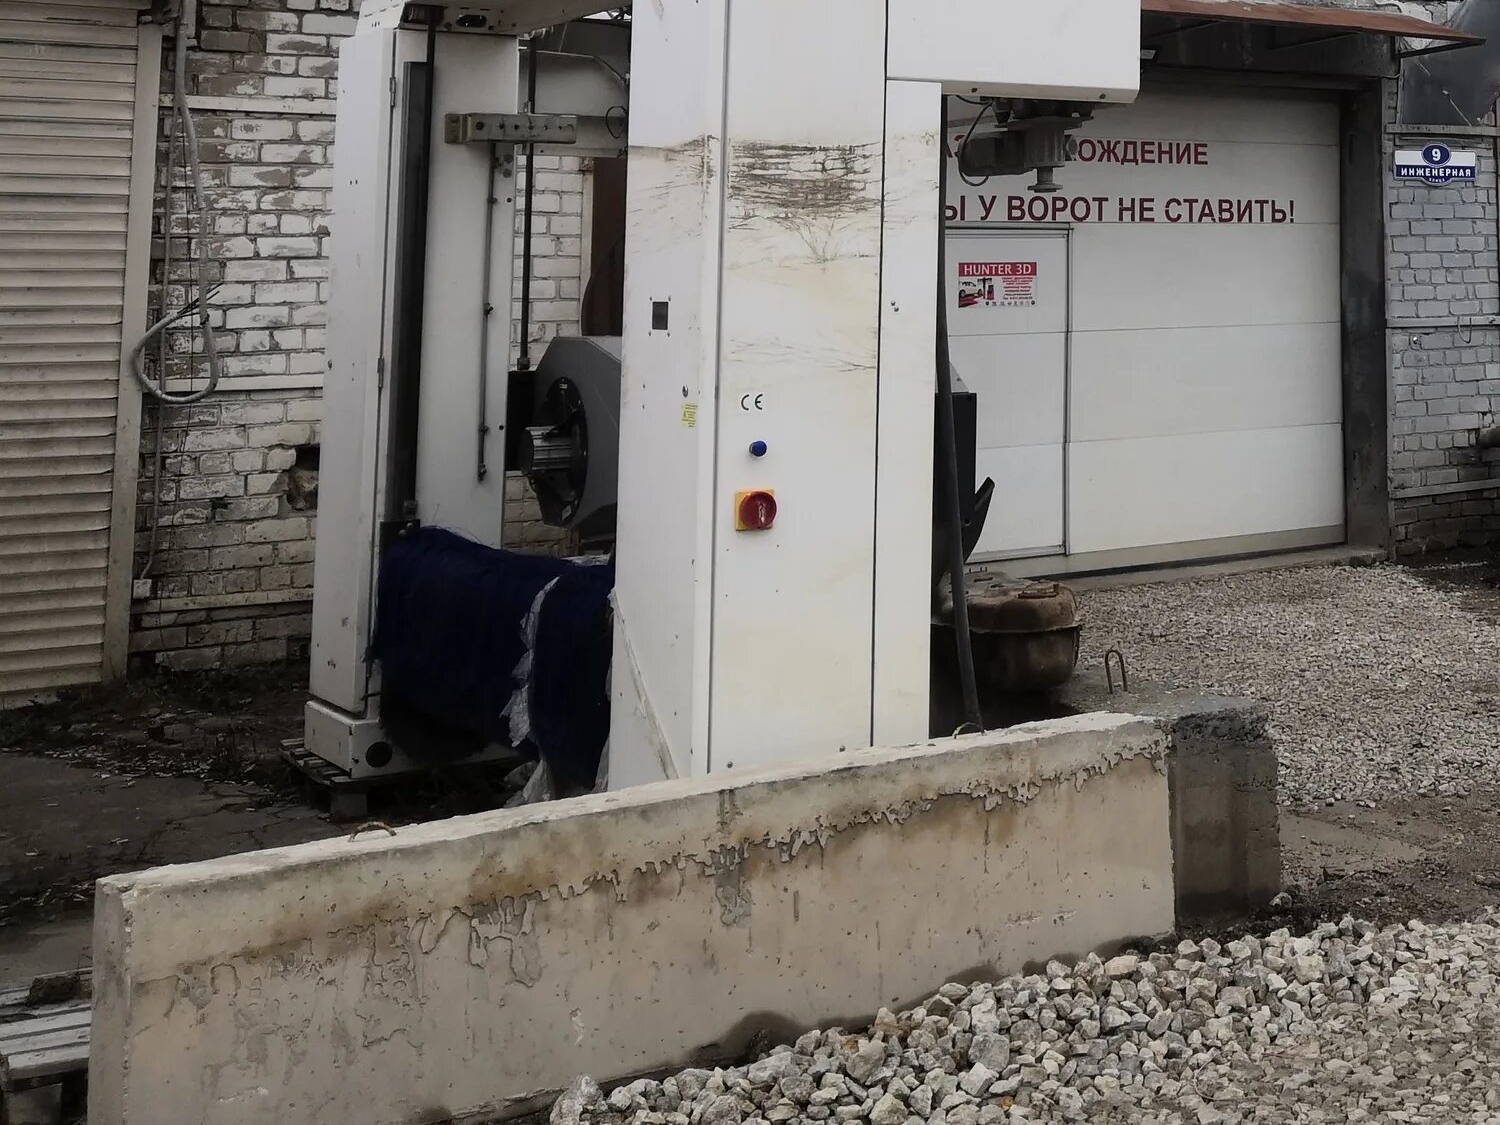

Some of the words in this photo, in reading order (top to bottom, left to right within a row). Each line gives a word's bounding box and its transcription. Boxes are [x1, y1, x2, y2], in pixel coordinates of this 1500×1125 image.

[1431, 148, 1441, 161] 9
[1401, 167, 1471, 177] ИНЖЕНЕРНАЯ
[978, 195, 997, 221] У
[1007, 195, 1108, 222] ВОРОТ
[1118, 197, 1154, 222] НЕ
[1164, 197, 1294, 224] СТАВИТЬ!
[964, 264, 1011, 275] HUNTER
[1015, 264, 1031, 274] 3D
